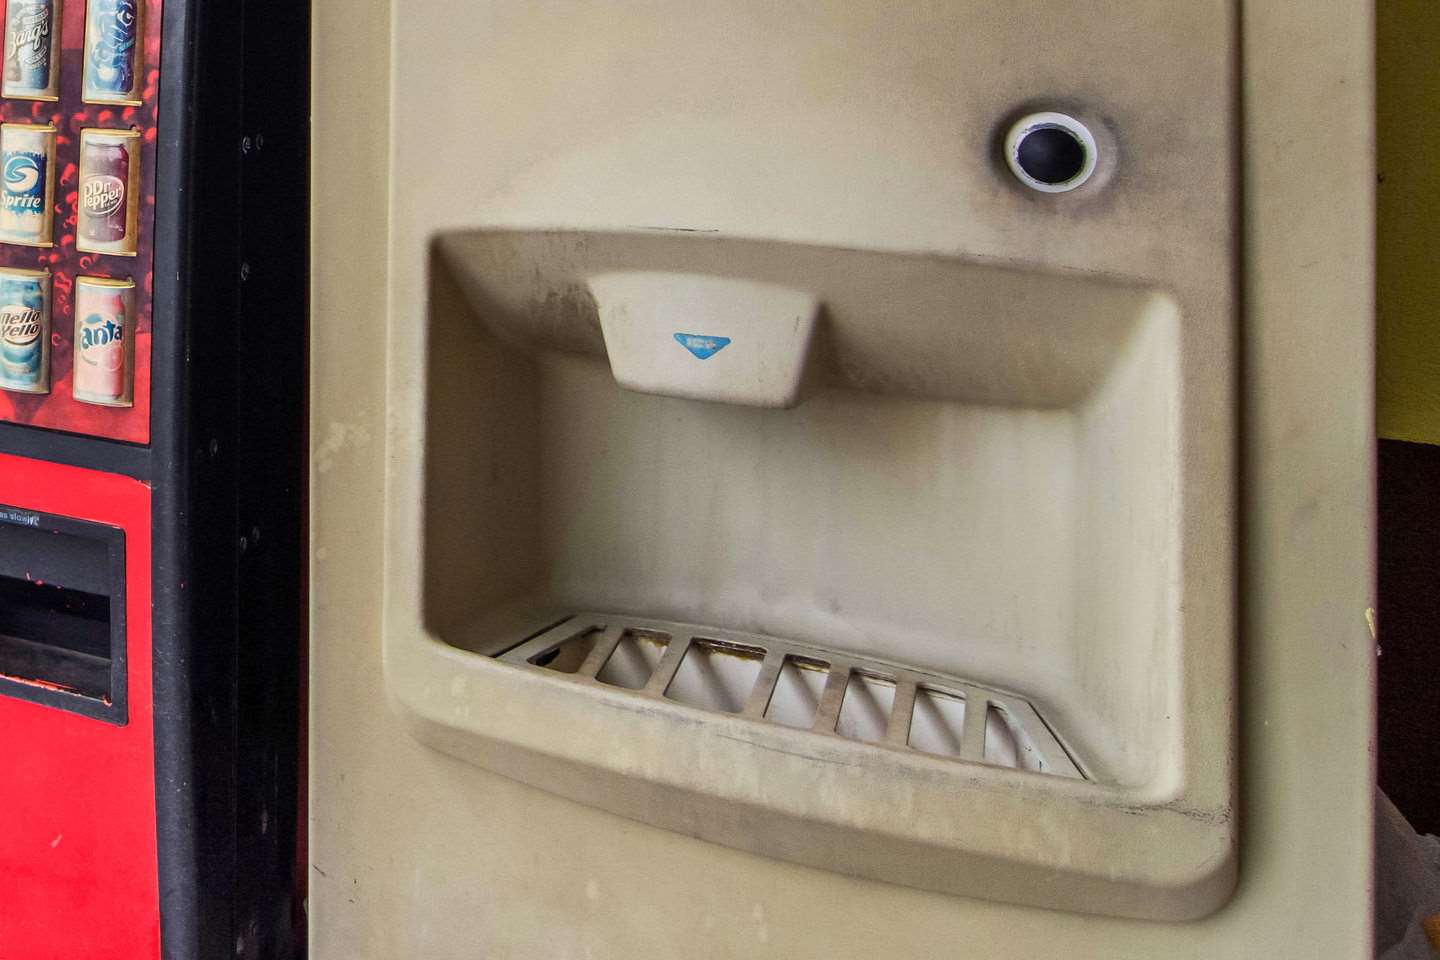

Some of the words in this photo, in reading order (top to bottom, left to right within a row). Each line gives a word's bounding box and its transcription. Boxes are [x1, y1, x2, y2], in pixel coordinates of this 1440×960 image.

[94, 180, 111, 196] Dr
[1, 189, 41, 209] Sprite
[81, 320, 123, 349] anta
